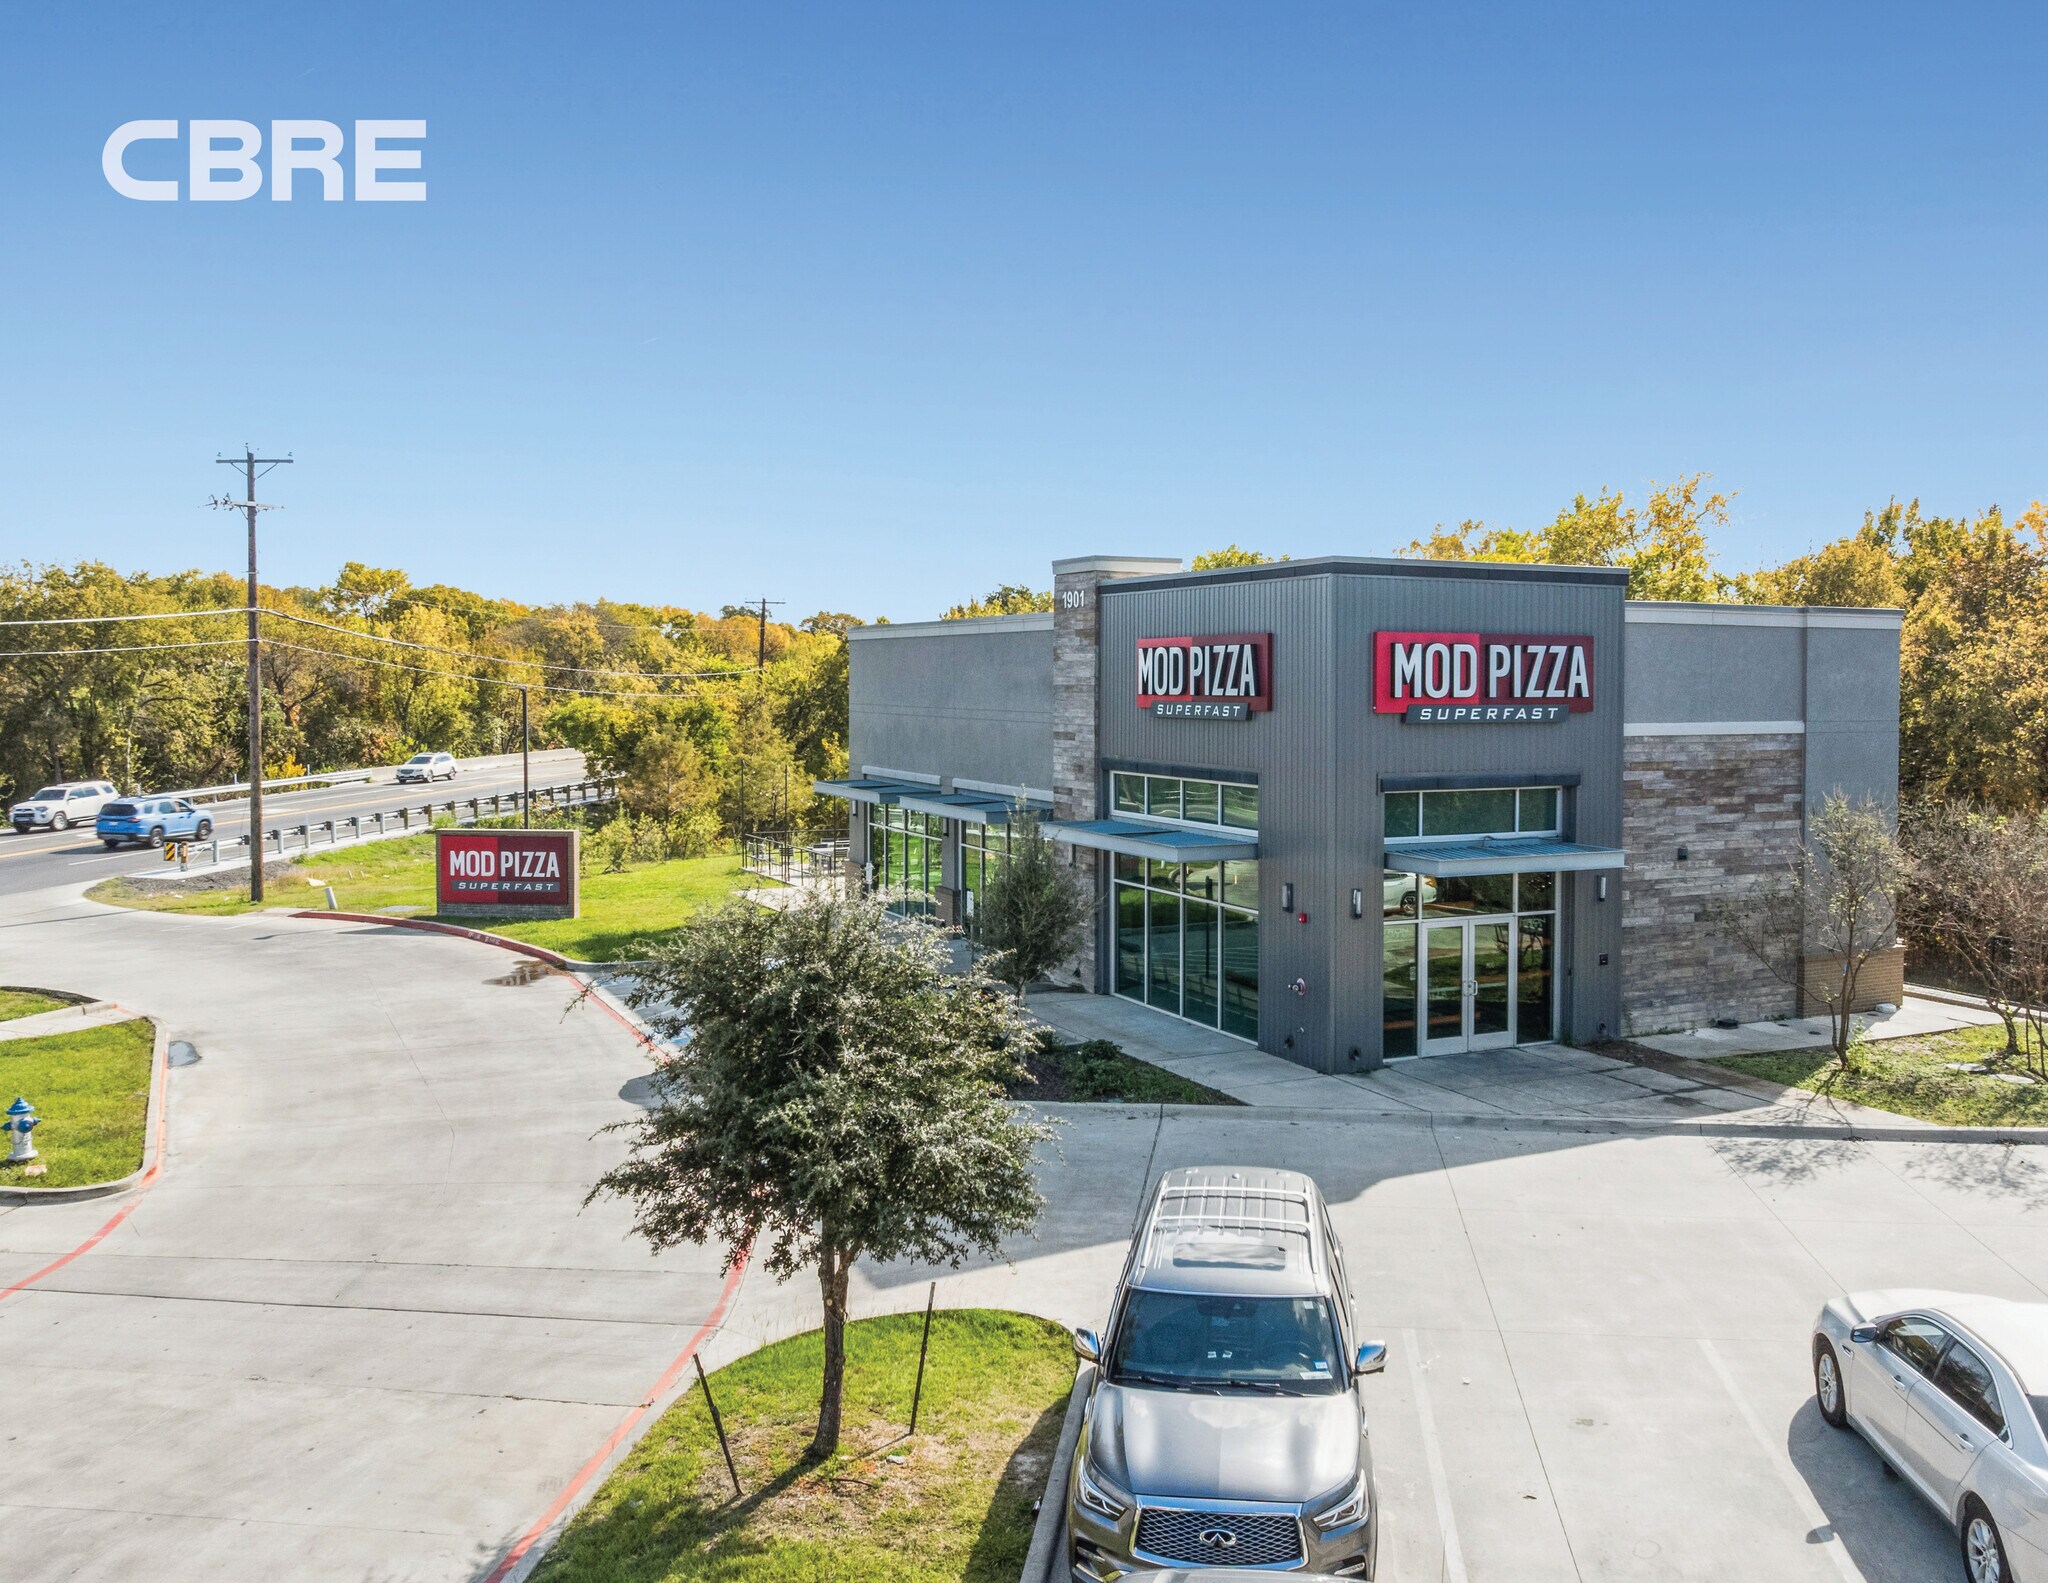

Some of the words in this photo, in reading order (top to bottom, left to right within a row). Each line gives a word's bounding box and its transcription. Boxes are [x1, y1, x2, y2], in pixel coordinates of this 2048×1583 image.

[1062, 590, 1085, 609] 1901
[1138, 646, 1184, 696] MOD
[1189, 643, 1256, 697] PIZZA
[1394, 642, 1479, 699] MOD
[1489, 643, 1590, 699] PIZZA
[1156, 703, 1241, 717] SUPERFAST
[1419, 707, 1559, 720] SUPERFAST
[449, 850, 496, 877] MOD
[500, 851, 561, 878] PIZZA
[458, 882, 554, 891] SUPERFAST
